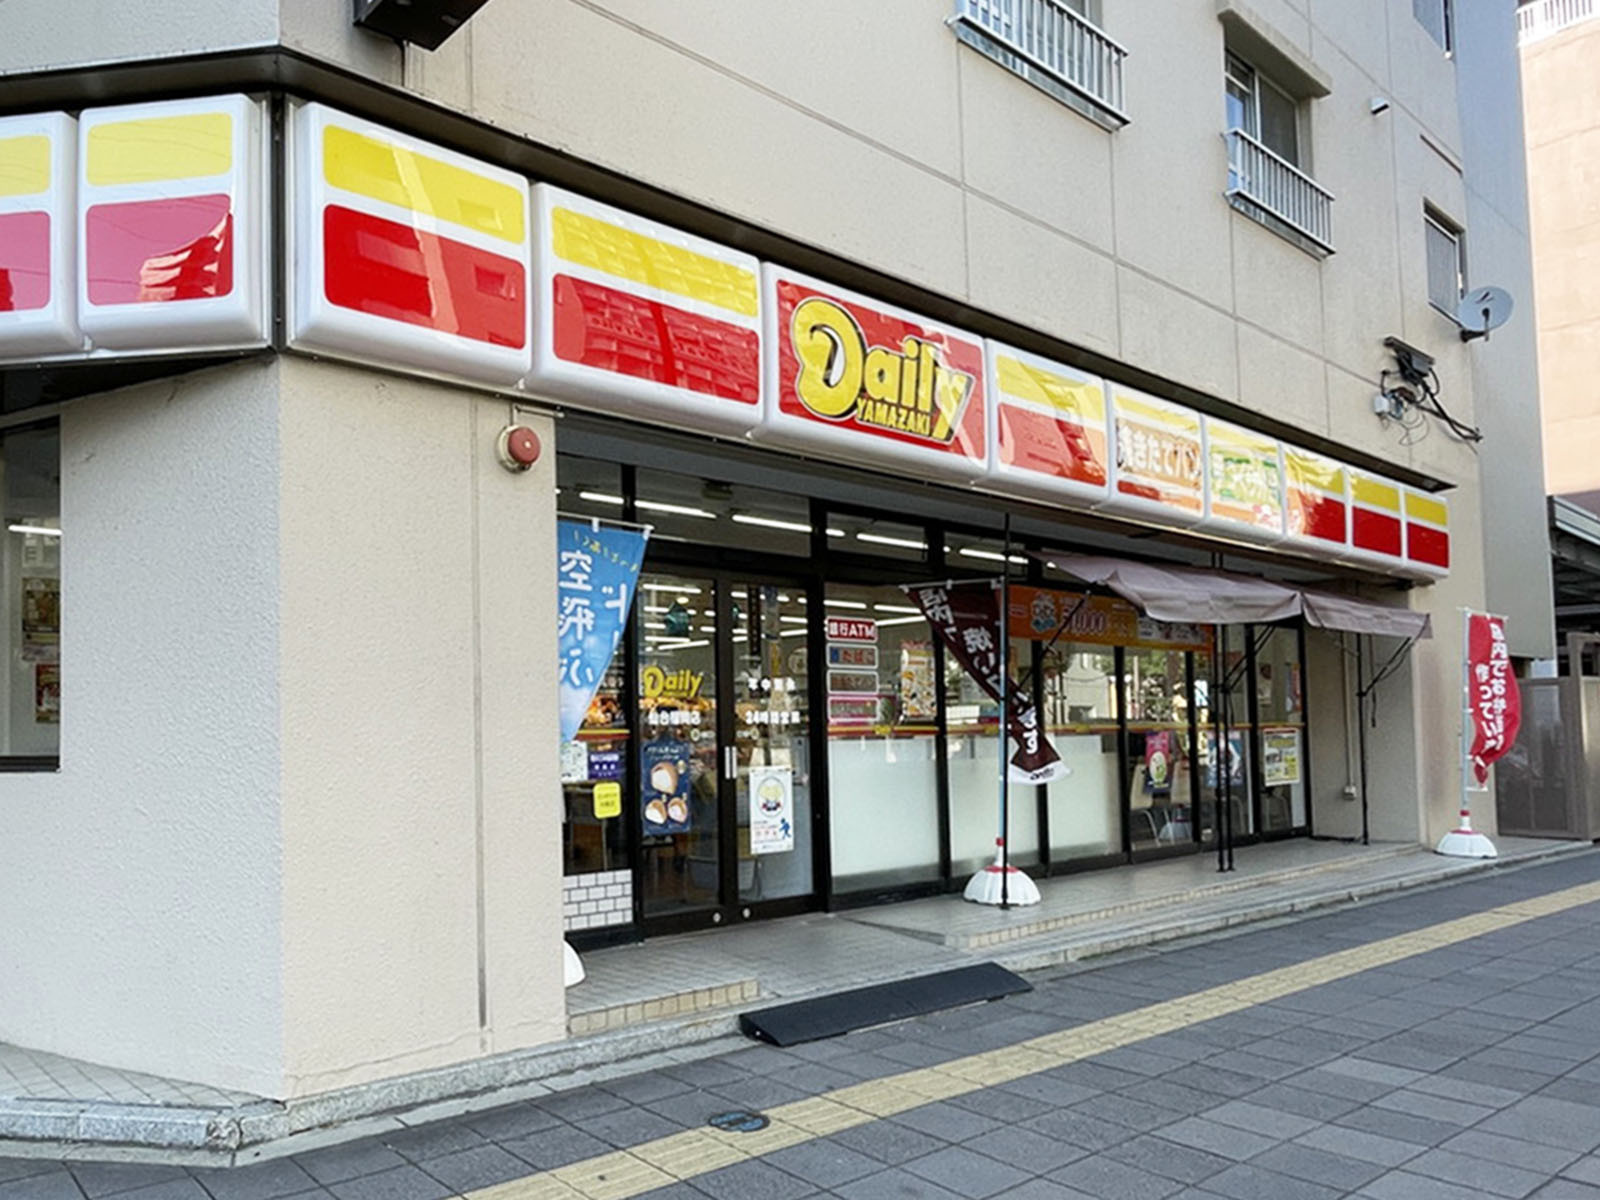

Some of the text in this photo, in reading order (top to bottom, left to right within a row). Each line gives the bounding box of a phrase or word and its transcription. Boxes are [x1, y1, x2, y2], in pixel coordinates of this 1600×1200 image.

[791, 297, 974, 441] Daily
[857, 397, 931, 437] YAMAZAKI
[644, 665, 703, 698] Daily
